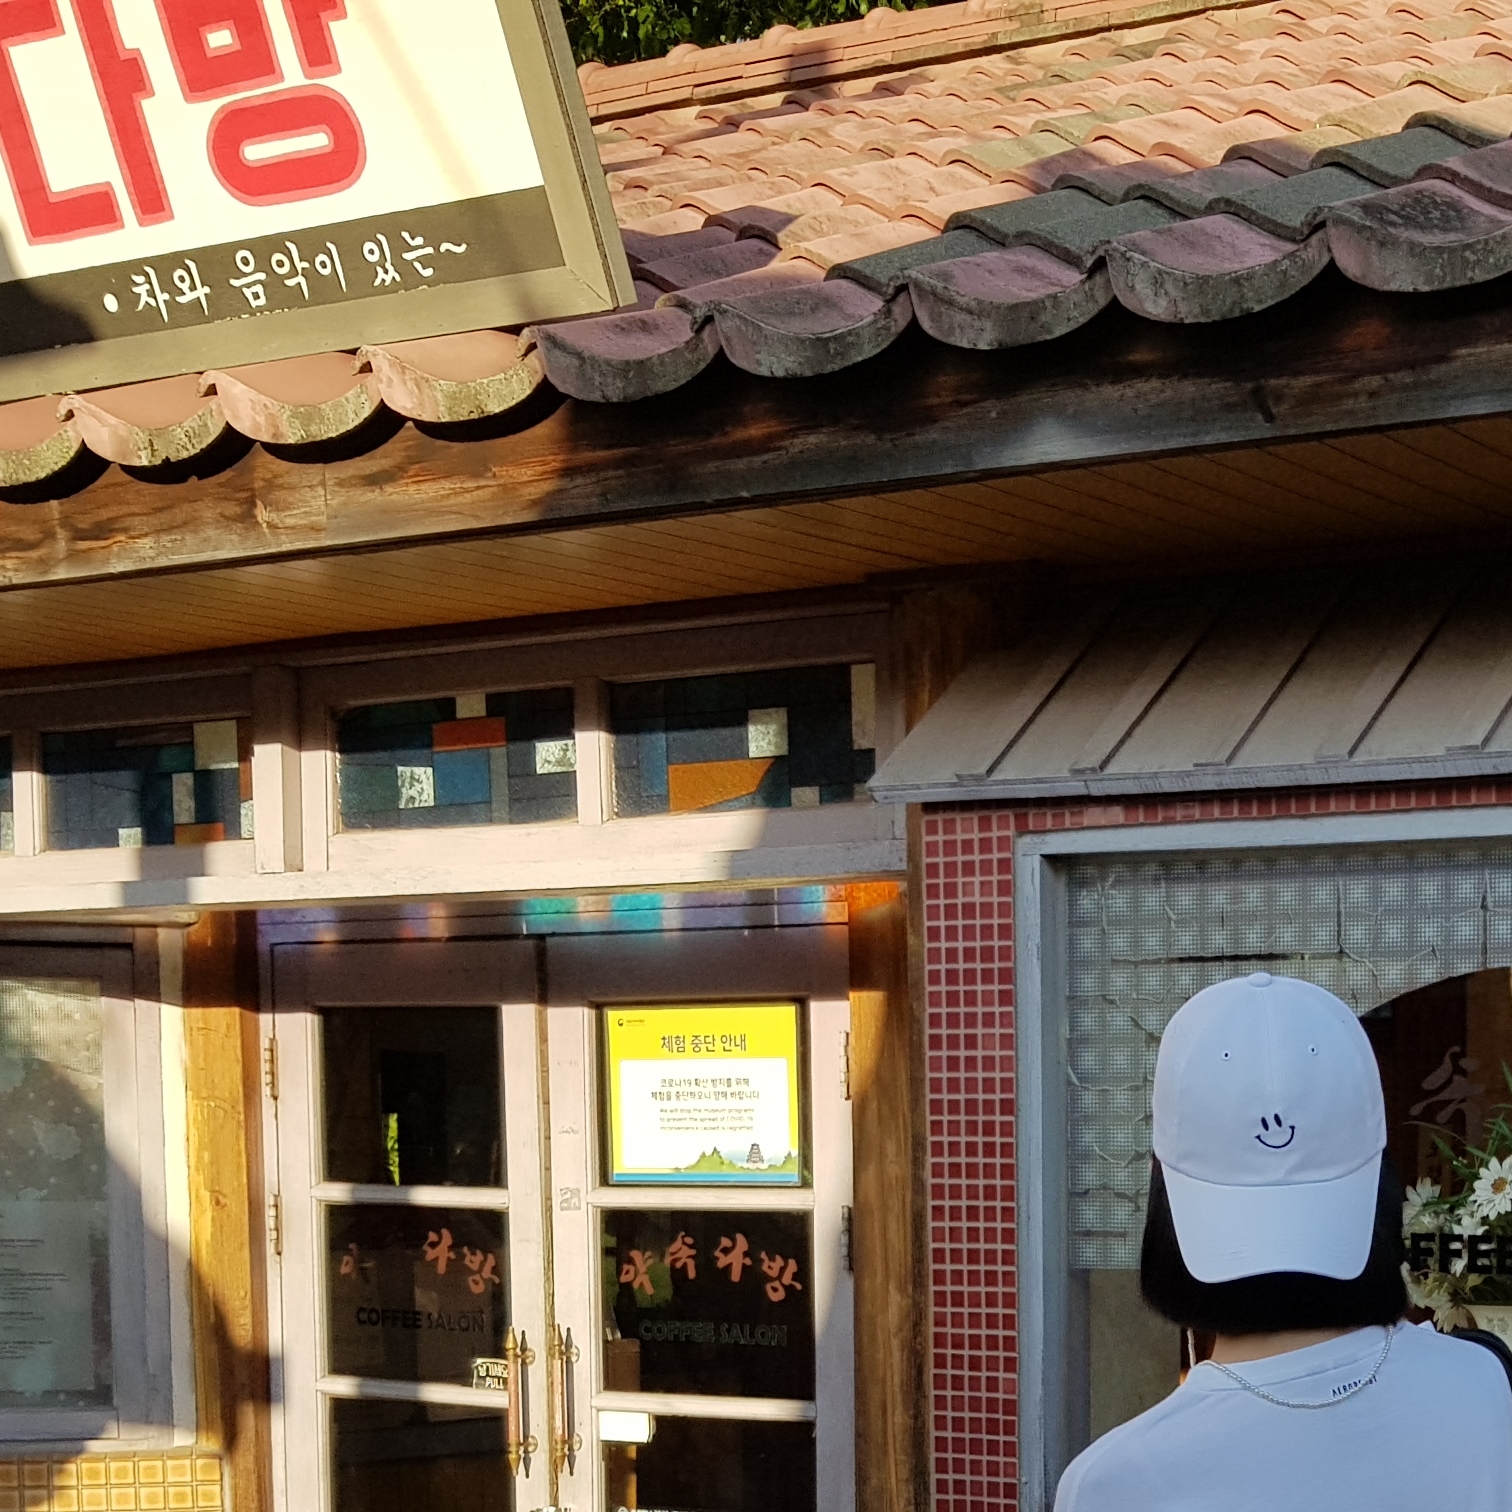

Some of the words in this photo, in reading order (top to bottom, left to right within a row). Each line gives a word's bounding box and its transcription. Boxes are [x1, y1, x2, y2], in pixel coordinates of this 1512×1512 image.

[131, 259, 211, 323] 차와
[229, 241, 347, 309] 음악이
[660, 1034, 686, 1054] 체험
[690, 1034, 716, 1053] 중단
[720, 1033, 747, 1052] 안내
[660, 1078, 692, 1088] 코로나19
[651, 1091, 672, 1101] 체험을
[356, 1307, 422, 1329] COFFEE
[427, 1310, 485, 1333] SALON
[639, 1320, 715, 1343] COFFEE
[720, 1323, 788, 1346] SALON
[485, 1377, 504, 1389] PULL
